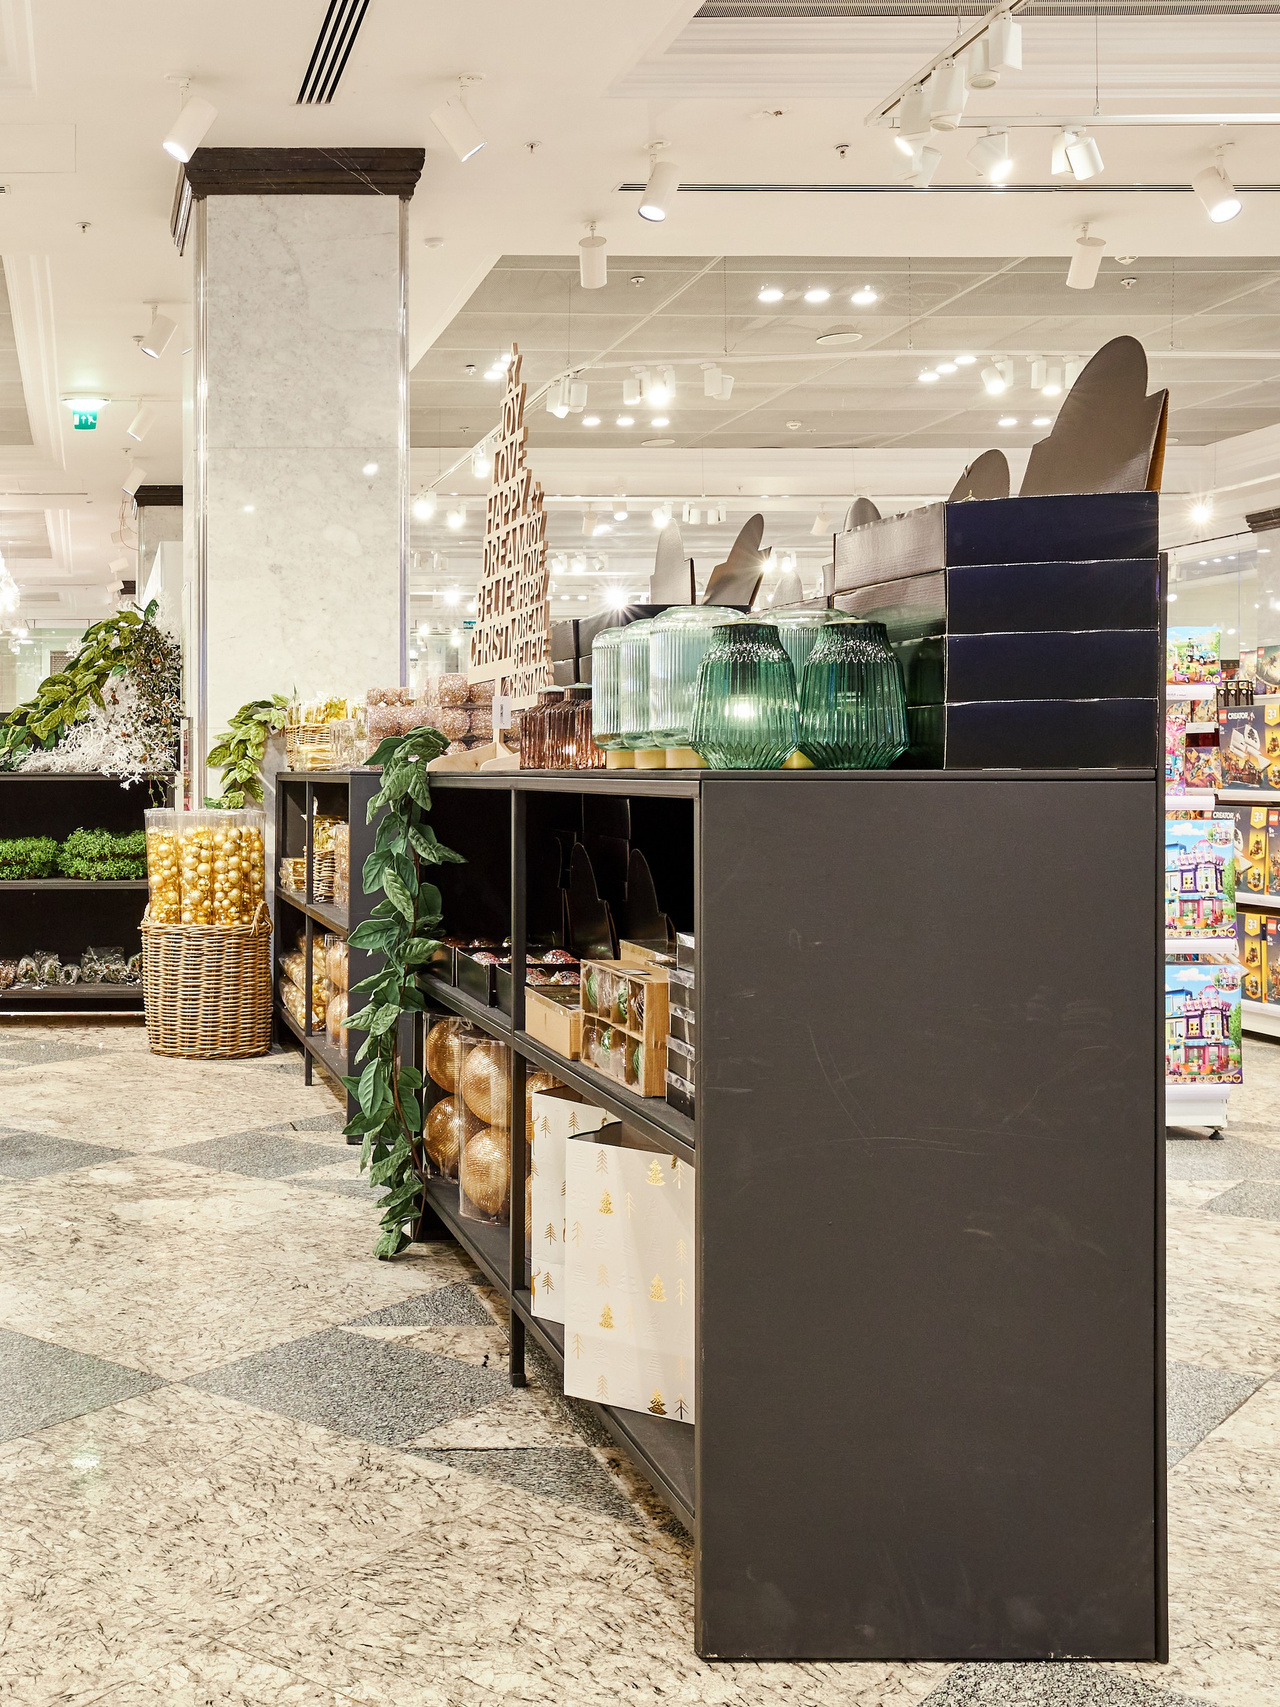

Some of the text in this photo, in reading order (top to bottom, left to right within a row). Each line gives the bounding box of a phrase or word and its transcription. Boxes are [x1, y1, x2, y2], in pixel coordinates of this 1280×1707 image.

[499, 389, 523, 442] JOY
[492, 434, 524, 487] LOVE
[486, 473, 527, 535] HAPPY
[477, 570, 523, 622] BELIEV
[519, 573, 544, 610] HAPPY
[470, 617, 519, 667] CHRISTM
[517, 604, 545, 639] DREAM
[513, 632, 548, 669] BELIEVE
[509, 664, 549, 698] CHRISTMAS
